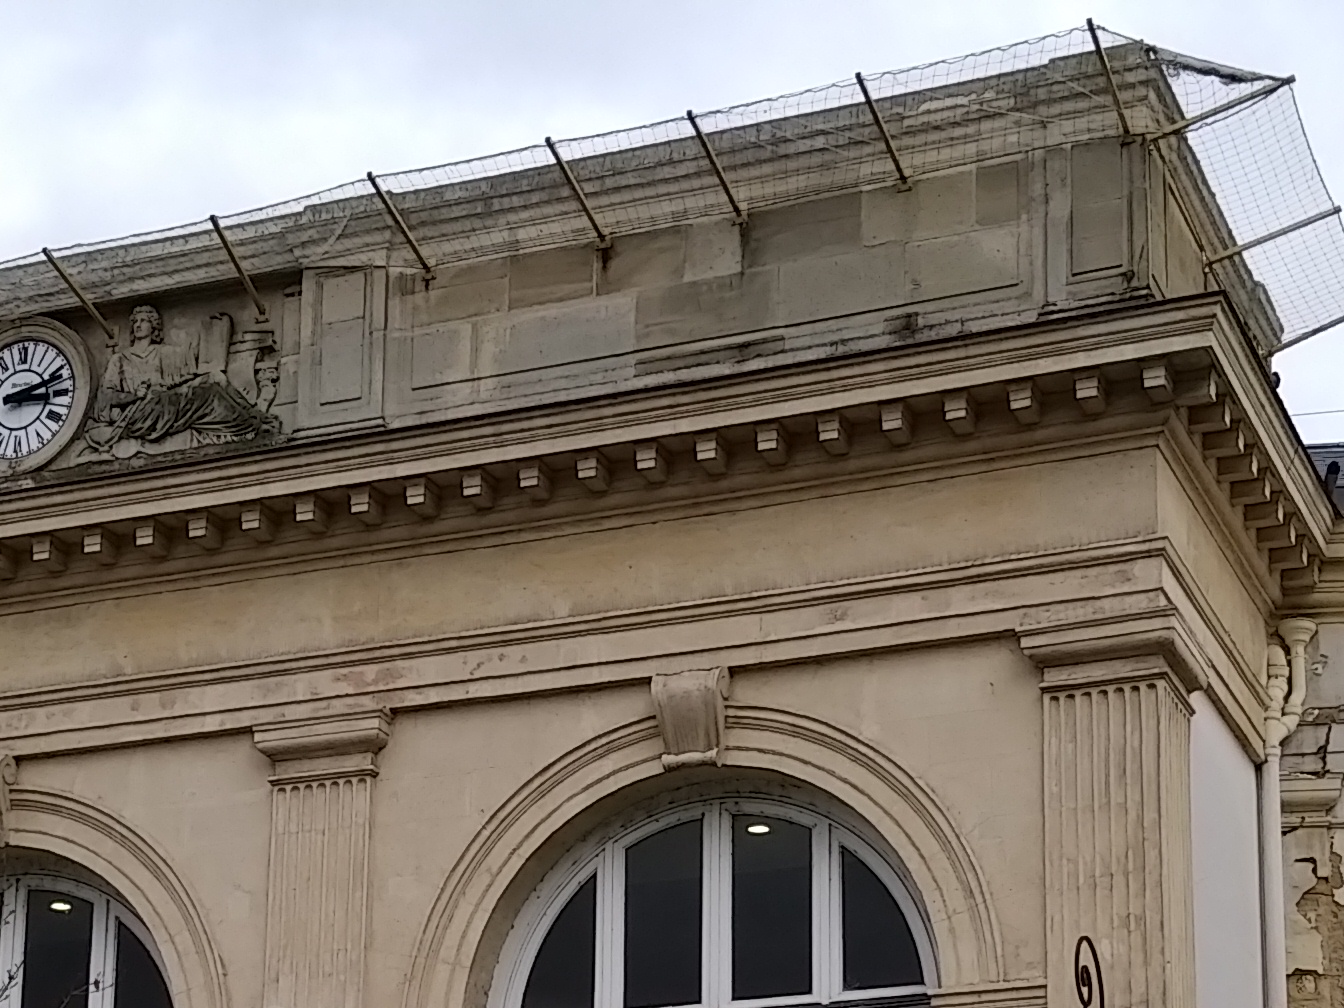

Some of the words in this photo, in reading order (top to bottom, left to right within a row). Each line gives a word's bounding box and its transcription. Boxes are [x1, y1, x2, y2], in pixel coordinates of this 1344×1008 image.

[17, 346, 29, 365] XII
[37, 346, 49, 367] I
[13, 435, 22, 453] VI
